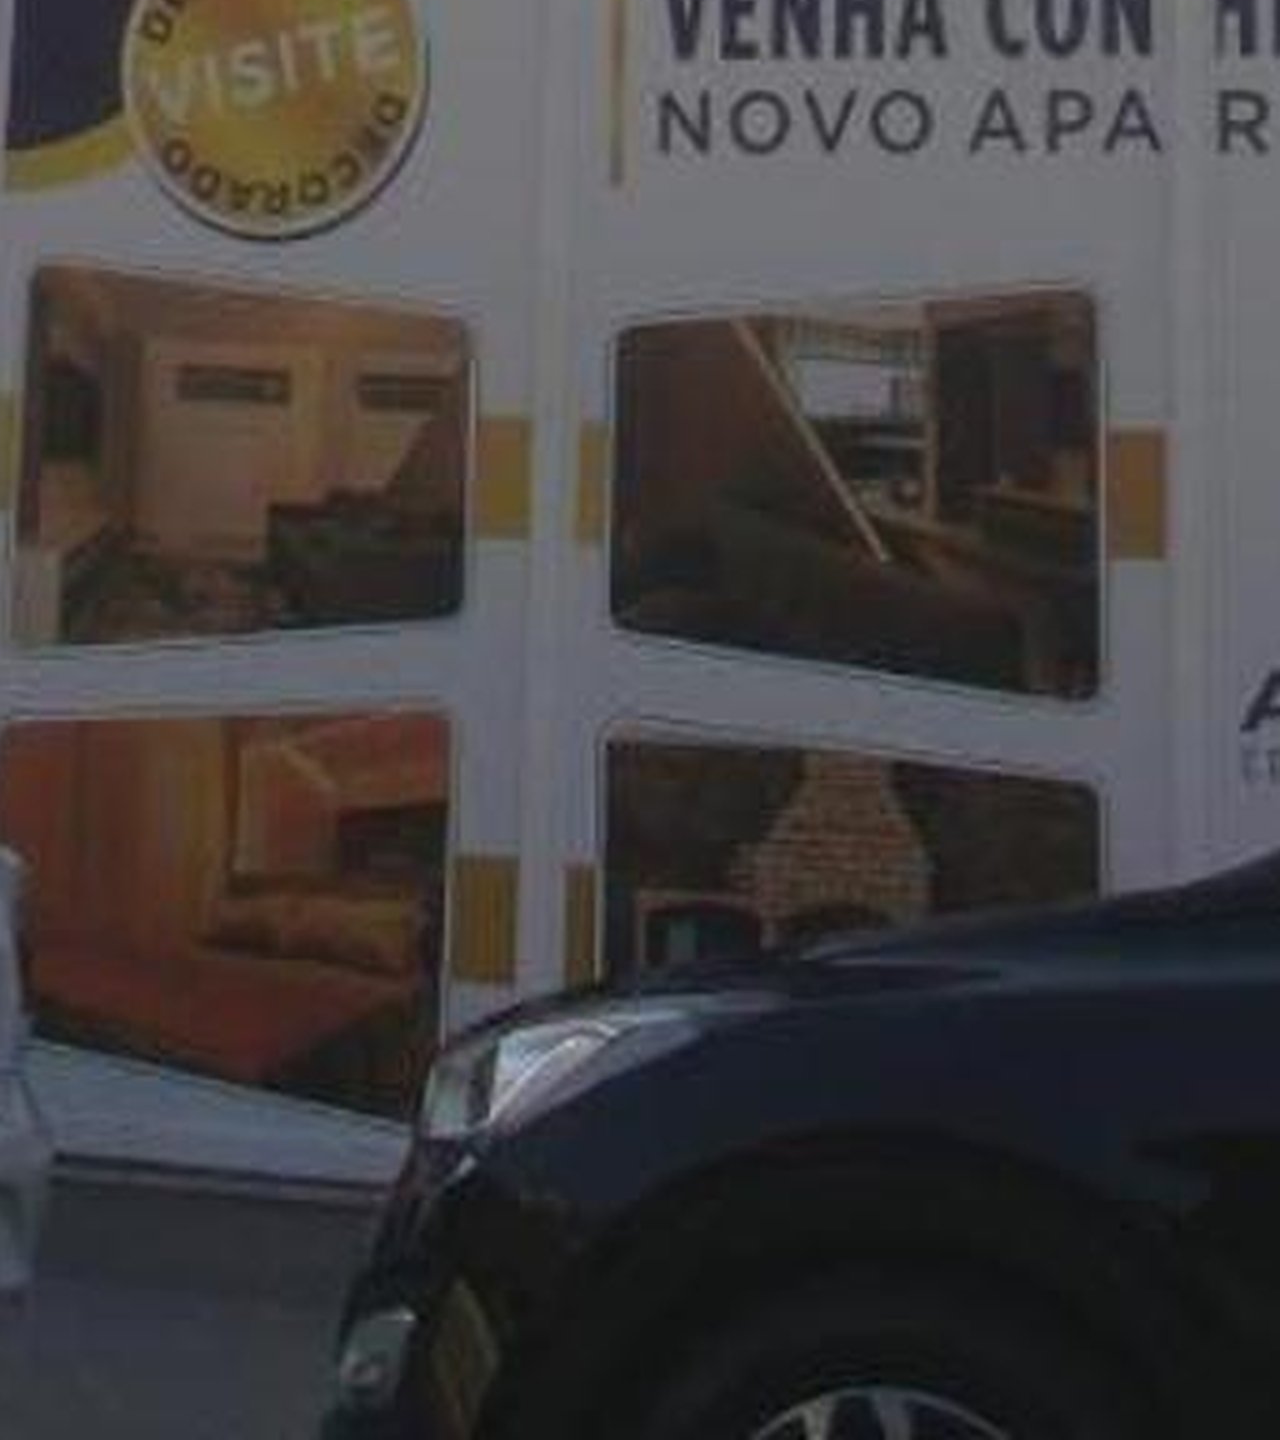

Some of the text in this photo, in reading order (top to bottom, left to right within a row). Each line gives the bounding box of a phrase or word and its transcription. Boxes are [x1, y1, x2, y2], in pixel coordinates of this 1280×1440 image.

[146, 8, 400, 126] VISITE
[656, 88, 933, 156] NOVO
[162, 90, 404, 214] DECORADO
